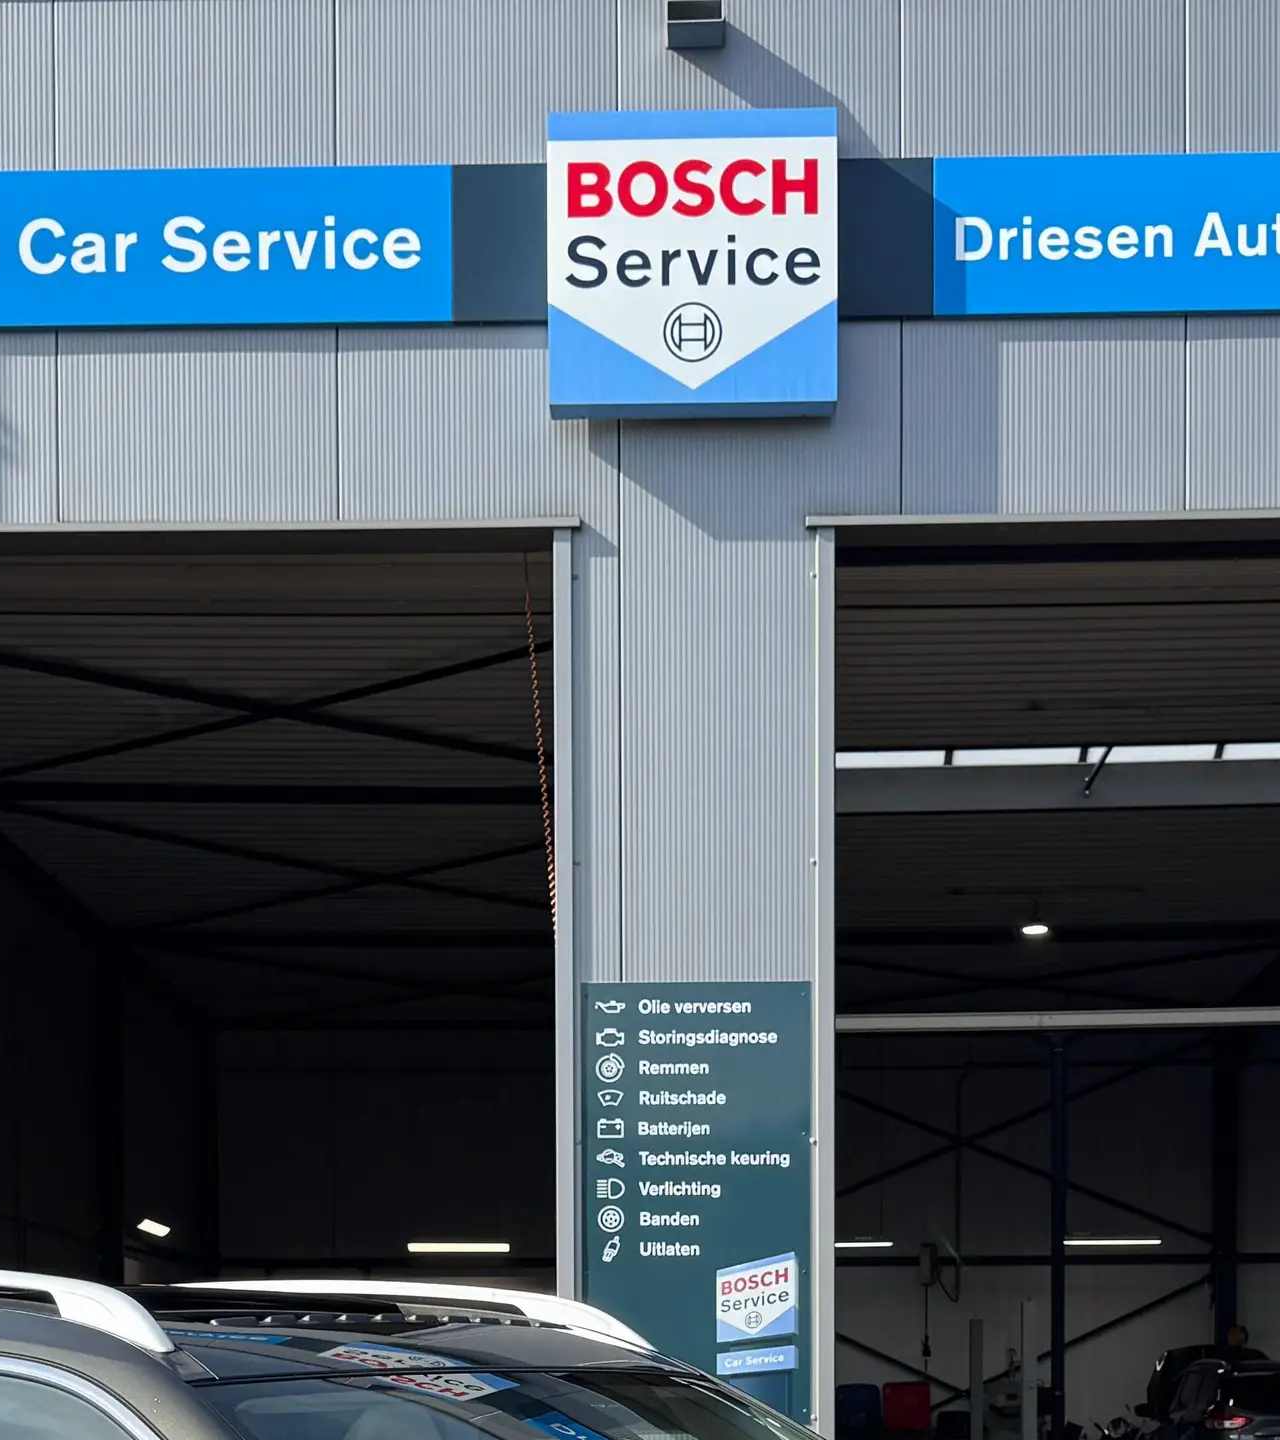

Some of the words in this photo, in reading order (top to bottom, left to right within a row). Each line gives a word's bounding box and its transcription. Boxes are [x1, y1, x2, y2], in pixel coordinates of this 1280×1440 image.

[566, 157, 820, 219] BOSCH
[17, 216, 139, 276] Car
[160, 213, 422, 274] Service
[954, 214, 1174, 262] Driesen
[565, 234, 821, 289] Service
[638, 999, 671, 1015] Olie
[674, 1001, 752, 1014] verversen
[638, 1029, 778, 1048] Storingsdiagnose
[638, 1060, 710, 1075] Remmen
[638, 1090, 727, 1105] Ruitschade
[638, 1121, 710, 1138] Batterijen
[638, 1150, 727, 1166] Technische
[730, 1150, 790, 1168] keuring
[638, 1181, 721, 1199] Verlichting
[639, 1211, 700, 1226] Banden
[639, 1241, 700, 1257] Uitlaten
[721, 1267, 789, 1296] BOSCH
[721, 1290, 789, 1313] Service
[724, 1358, 743, 1368] Car
[745, 1354, 785, 1367] Service
